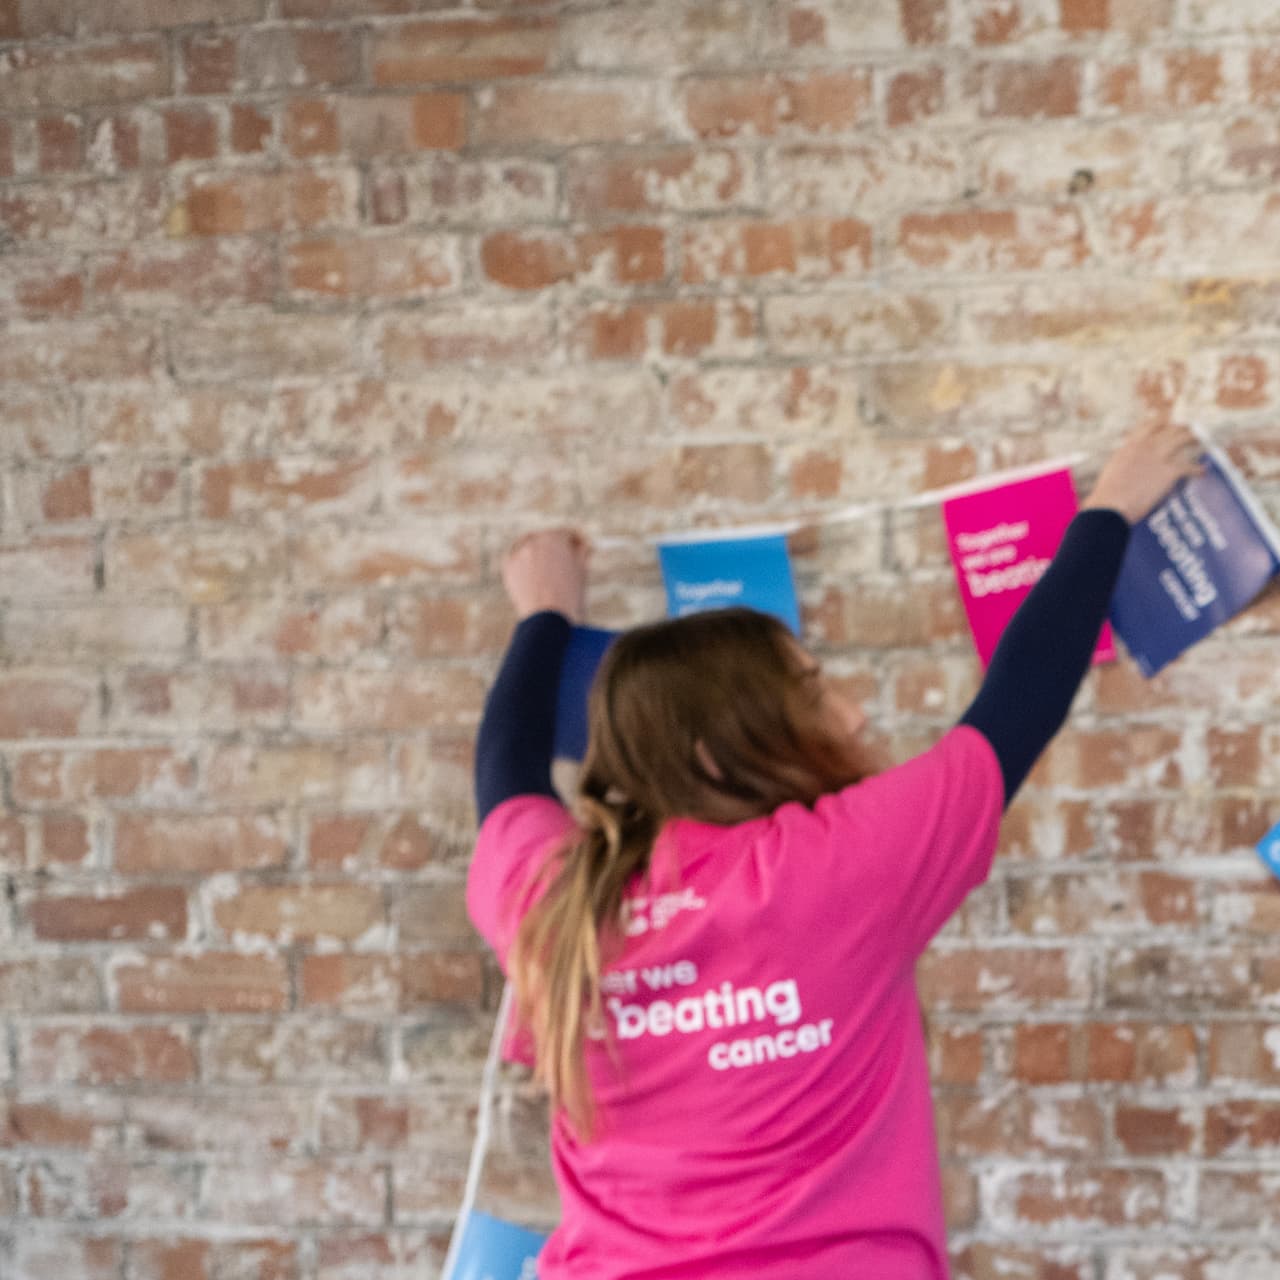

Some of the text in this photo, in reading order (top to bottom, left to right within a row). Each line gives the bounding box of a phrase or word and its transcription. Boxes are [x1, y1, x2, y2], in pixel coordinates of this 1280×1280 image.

[641, 960, 698, 992] we
[607, 979, 801, 1040] beating
[708, 1018, 833, 1070] cancer
